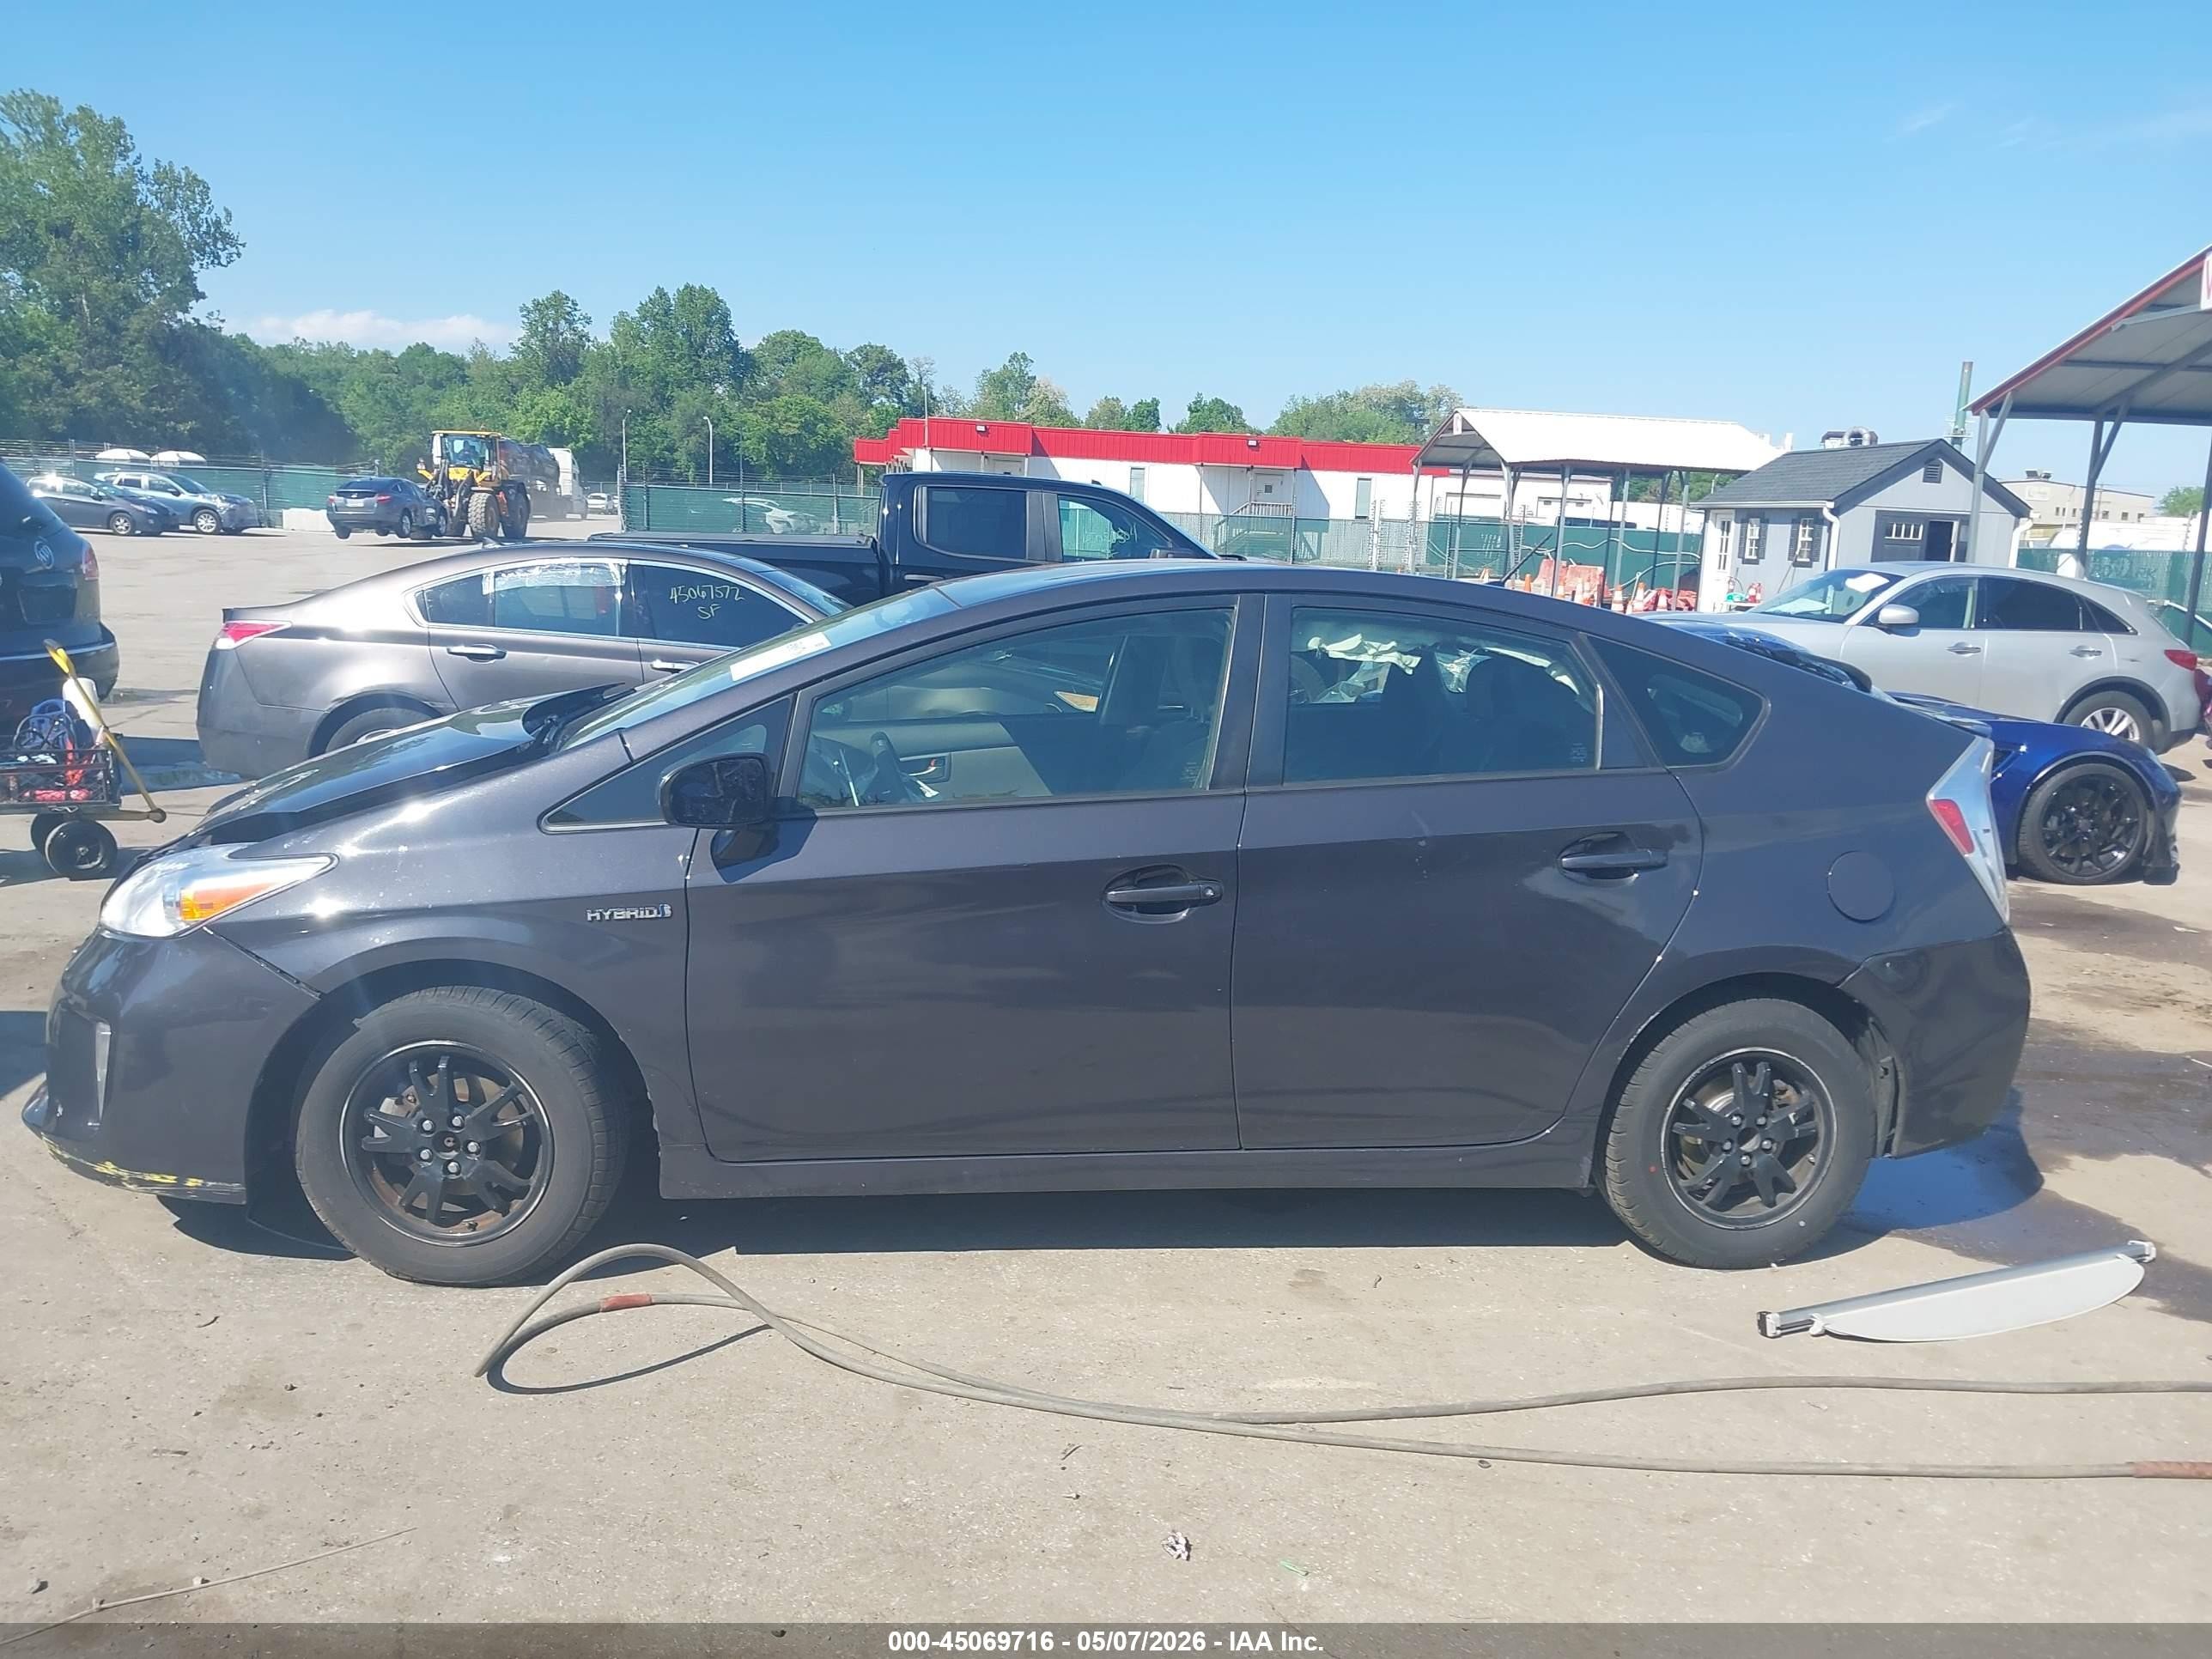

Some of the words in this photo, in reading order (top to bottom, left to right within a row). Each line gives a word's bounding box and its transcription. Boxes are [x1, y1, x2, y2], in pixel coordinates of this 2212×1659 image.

[669, 584, 745, 605] 45067572
[696, 603, 722, 620] SF
[586, 907, 658, 921] HYBRID
